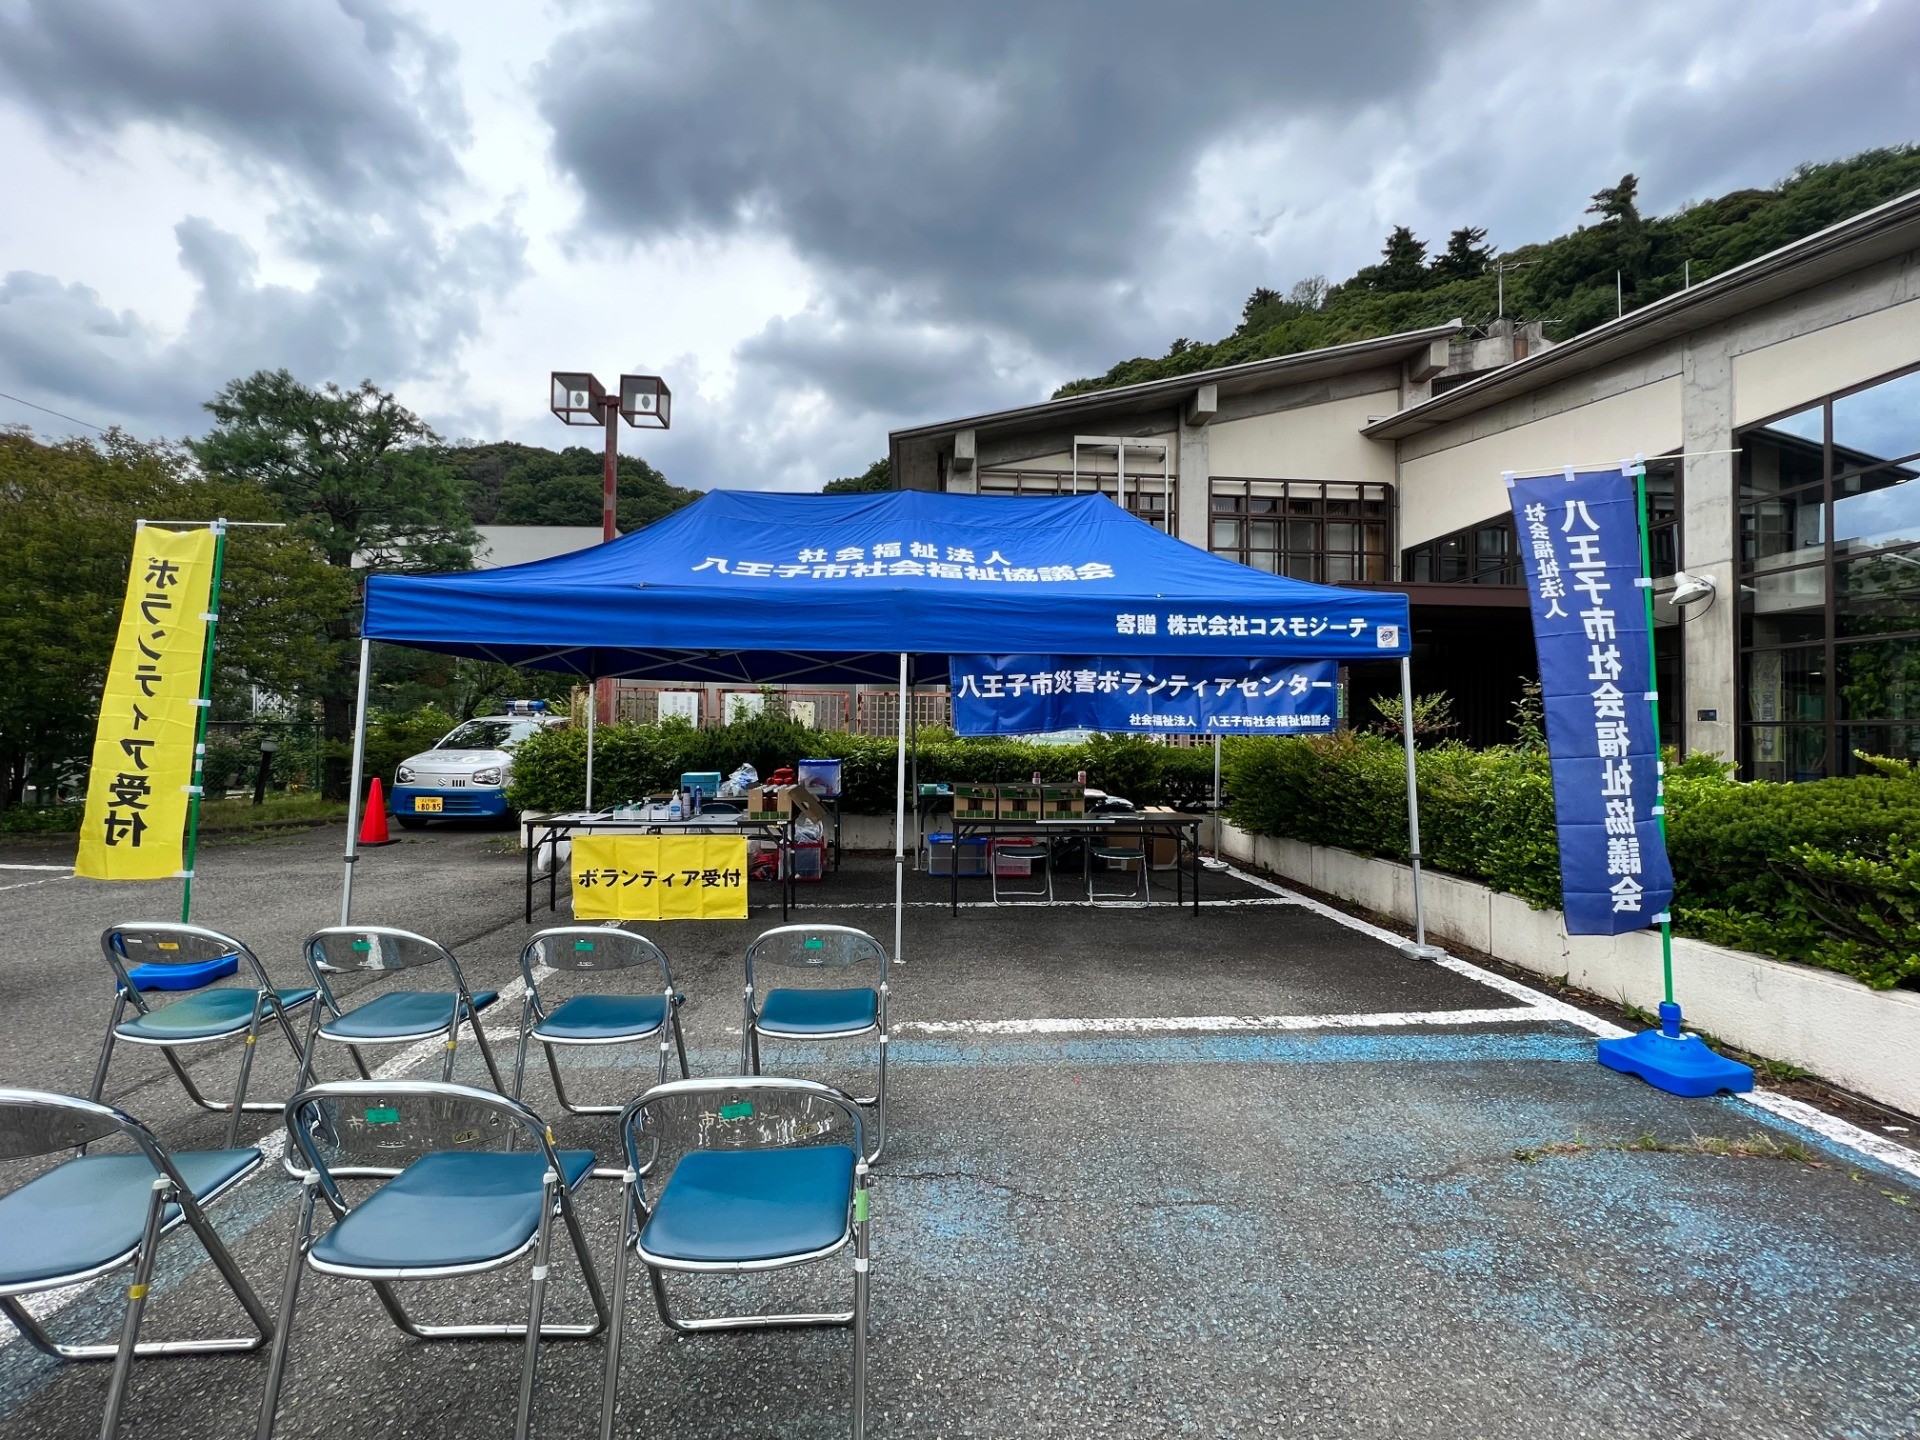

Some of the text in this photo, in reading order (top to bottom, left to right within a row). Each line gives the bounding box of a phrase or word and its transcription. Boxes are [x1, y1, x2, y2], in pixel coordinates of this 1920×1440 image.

[798, 541, 1012, 566] 社会福祉法人
[691, 556, 1116, 583] 八王子市社会福祉協議会
[1115, 614, 1157, 635] 寄贈
[1167, 614, 1368, 638] 株式会社コスモジーテ
[957, 669, 1332, 699] 八王子市災害ボランティアセンター
[1129, 713, 1331, 728] 社会福祉法人 八王子市社会福祉協議会
[578, 868, 742, 888] ボランティア受付
